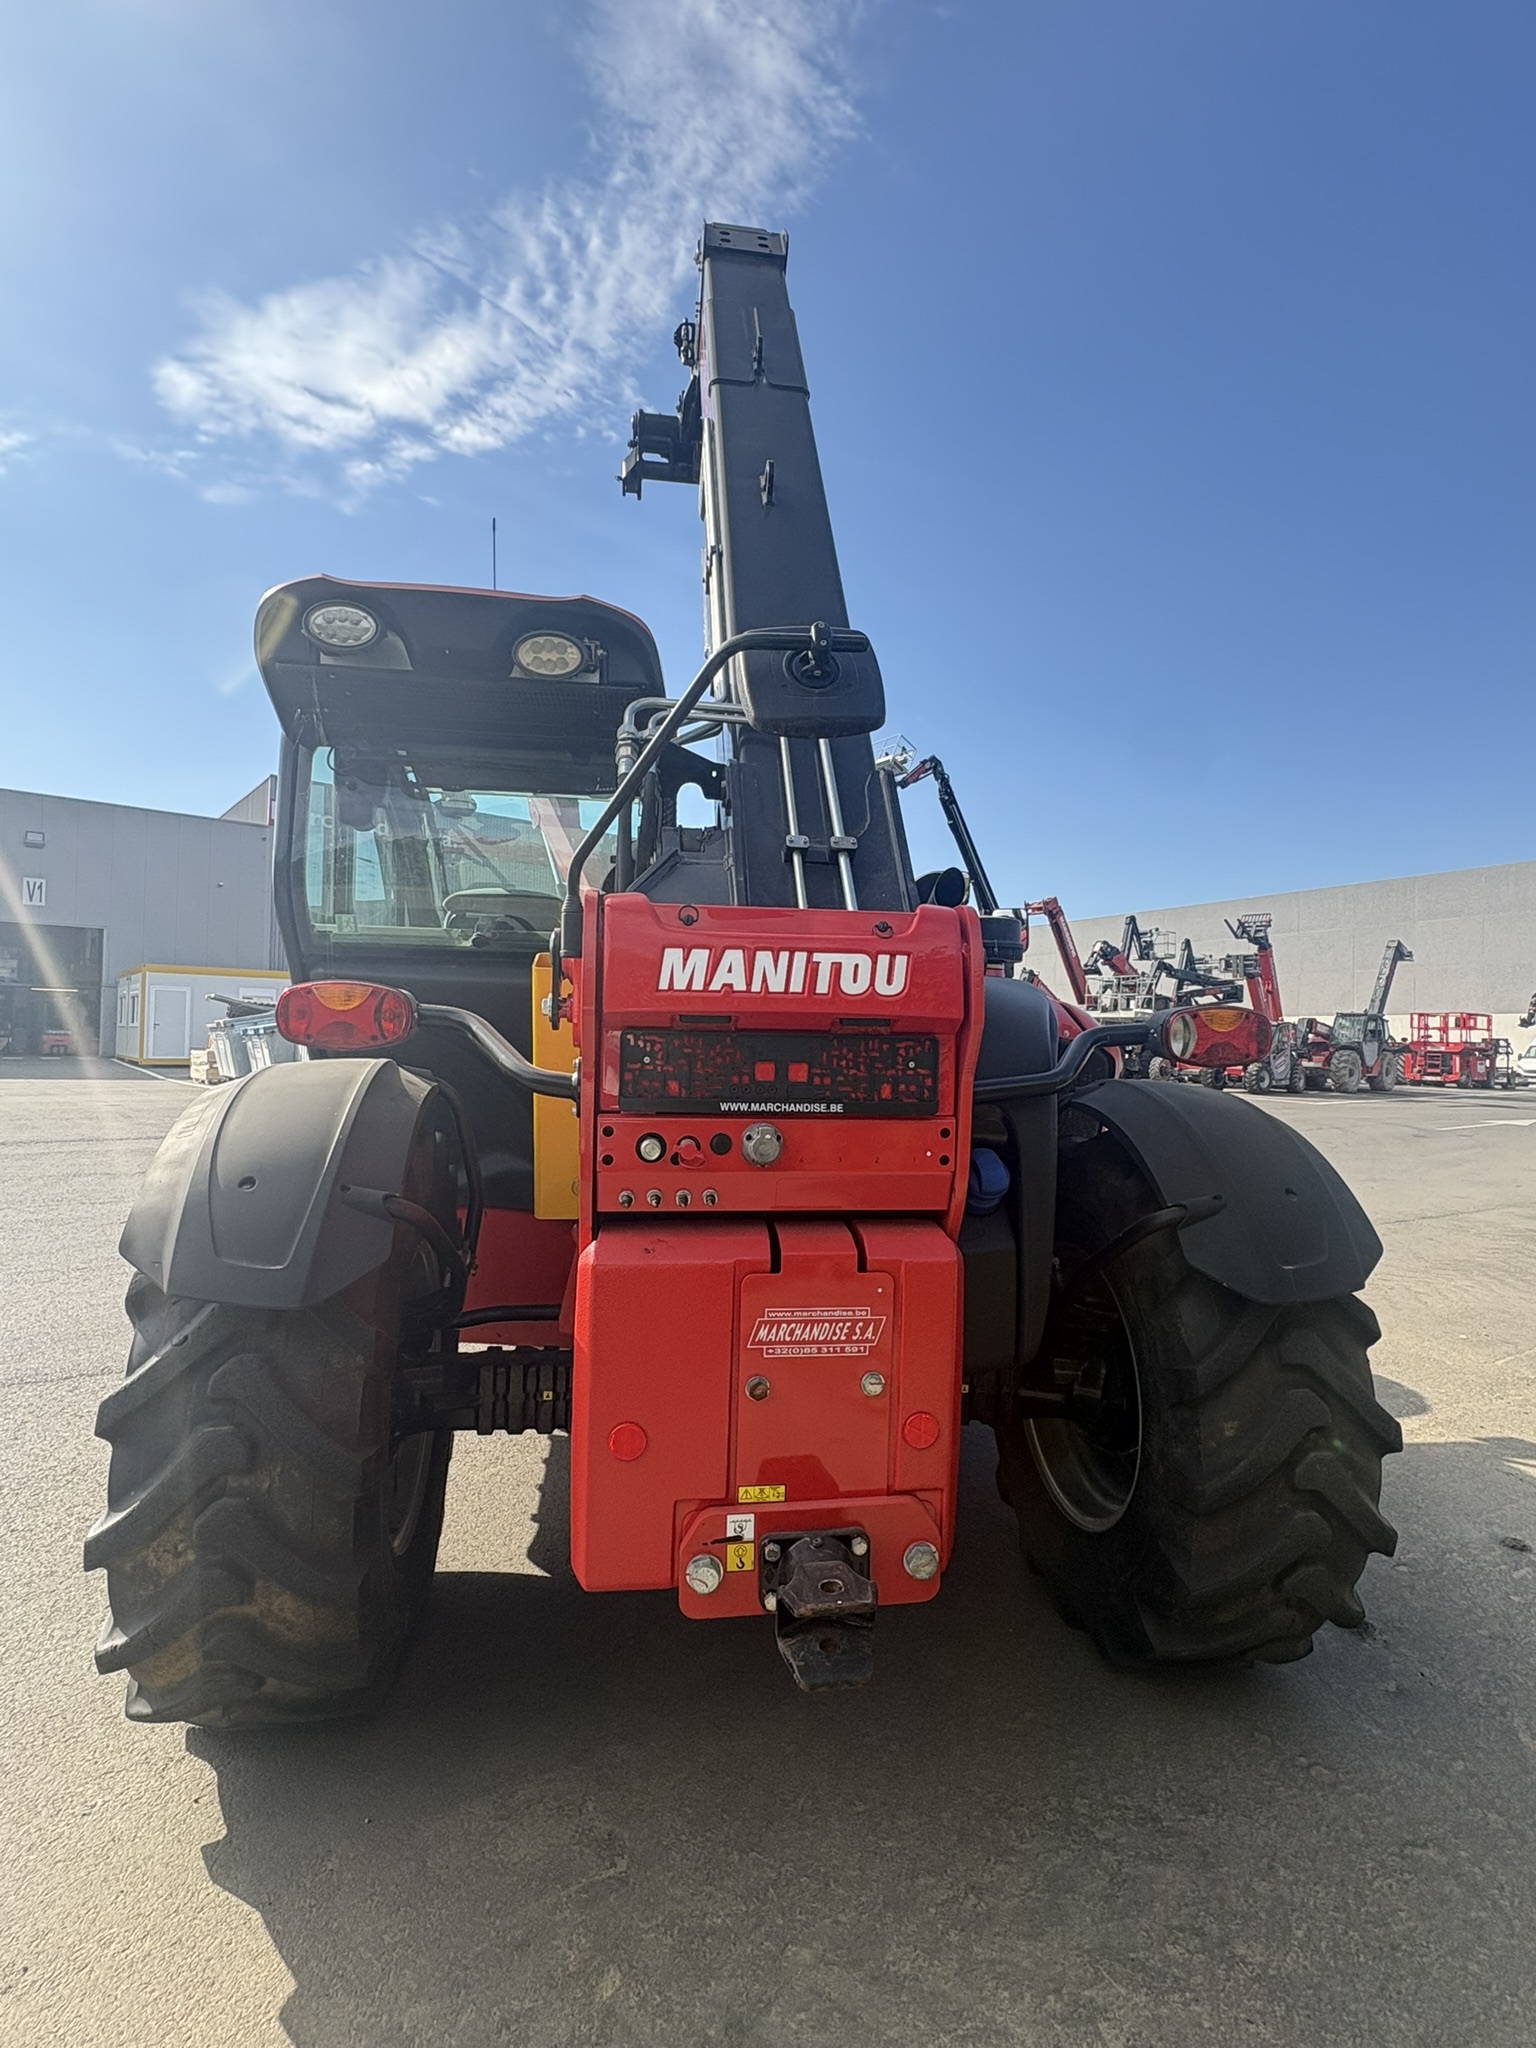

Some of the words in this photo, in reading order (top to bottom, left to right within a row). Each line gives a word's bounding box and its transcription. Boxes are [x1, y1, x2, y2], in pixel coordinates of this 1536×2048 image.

[26, 880, 43, 903] V1
[657, 948, 908, 996] MANITOU
[719, 1102, 844, 1113] WWW.MARCHANDISE.BE
[767, 1310, 867, 1318] www.marchandise.be
[755, 1322, 852, 1342] MARCHANDISE
[852, 1322, 876, 1340] S.A.
[767, 1347, 818, 1355] +32(0)85
